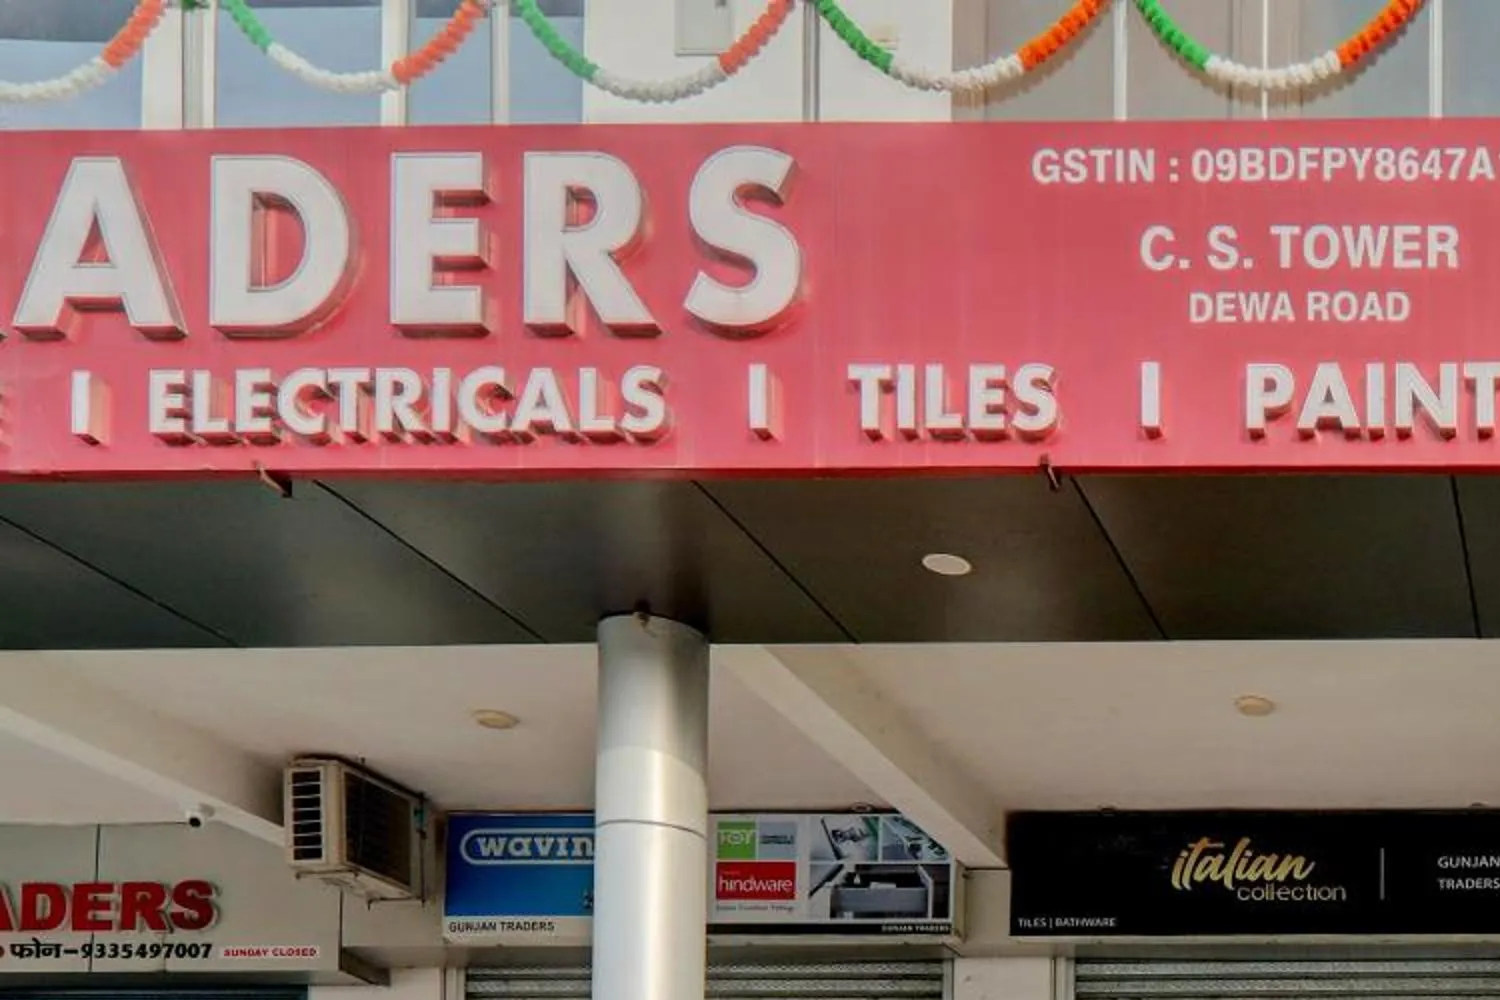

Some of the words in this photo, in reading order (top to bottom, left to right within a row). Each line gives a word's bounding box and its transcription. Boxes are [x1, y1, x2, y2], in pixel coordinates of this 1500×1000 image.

[1032, 147, 1157, 184] GSTIN
[1139, 225, 1190, 270] C.
[1207, 225, 1254, 269] S.
[1270, 225, 1460, 269] TOWER
[1189, 291, 1297, 323] DEWA
[1306, 290, 1411, 322] ROAD
[148, 365, 670, 441] ELECTRICALS
[847, 362, 1060, 438] TILES
[475, 835, 594, 857] wavin
[1171, 836, 1315, 891] italian
[718, 874, 793, 893] hindware
[1236, 882, 1346, 901] collection
[448, 921, 497, 933] GUNJAN
[499, 920, 555, 932] TRADERS
[1018, 917, 1047, 929] TILES
[1056, 917, 1118, 929] BATHWARE
[272, 946, 317, 957] CLOSED
